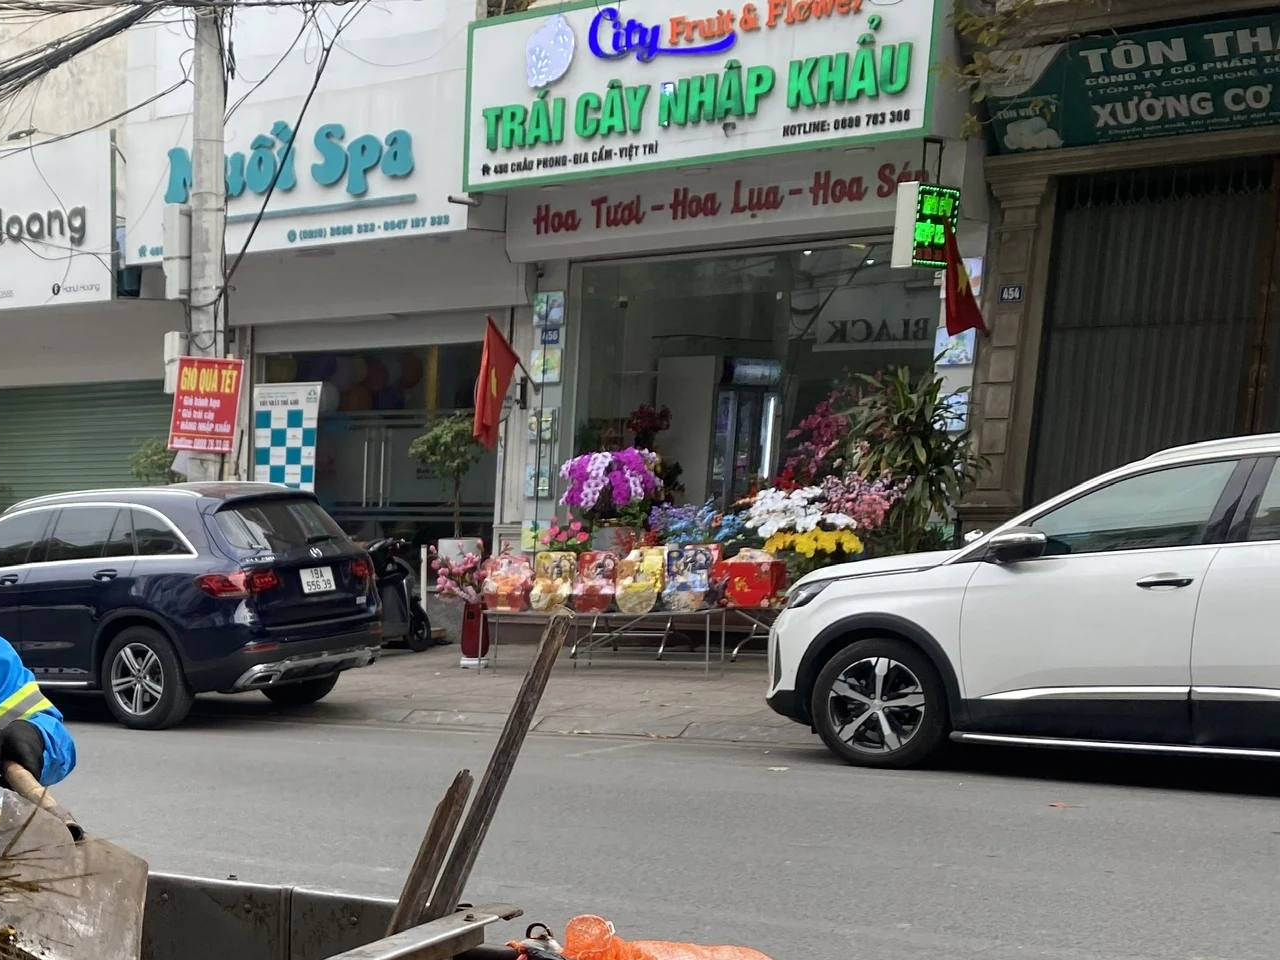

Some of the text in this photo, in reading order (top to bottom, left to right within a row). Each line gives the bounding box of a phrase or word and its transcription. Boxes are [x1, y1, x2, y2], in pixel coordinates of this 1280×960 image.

[588, 7, 661, 63] City
[668, 9, 736, 45] Fruit
[740, 2, 761, 31] &
[1079, 38, 1188, 73] TÔN
[482, 89, 567, 151] TRÁI
[574, 78, 651, 138] CÂY
[787, 14, 914, 109] KHẨU
[1091, 84, 1274, 128] XƯỞNG CƠ
[310, 122, 415, 197] Spa
[533, 203, 582, 235] Hoa
[669, 187, 721, 221] Hoa
[809, 170, 868, 206] Hoa
[1002, 287, 1020, 300] 454
[180, 360, 238, 394] GIỎ QUÀ TẾT
[306, 579, 332, 592] 556.39
[310, 568, 325, 580] 19A
